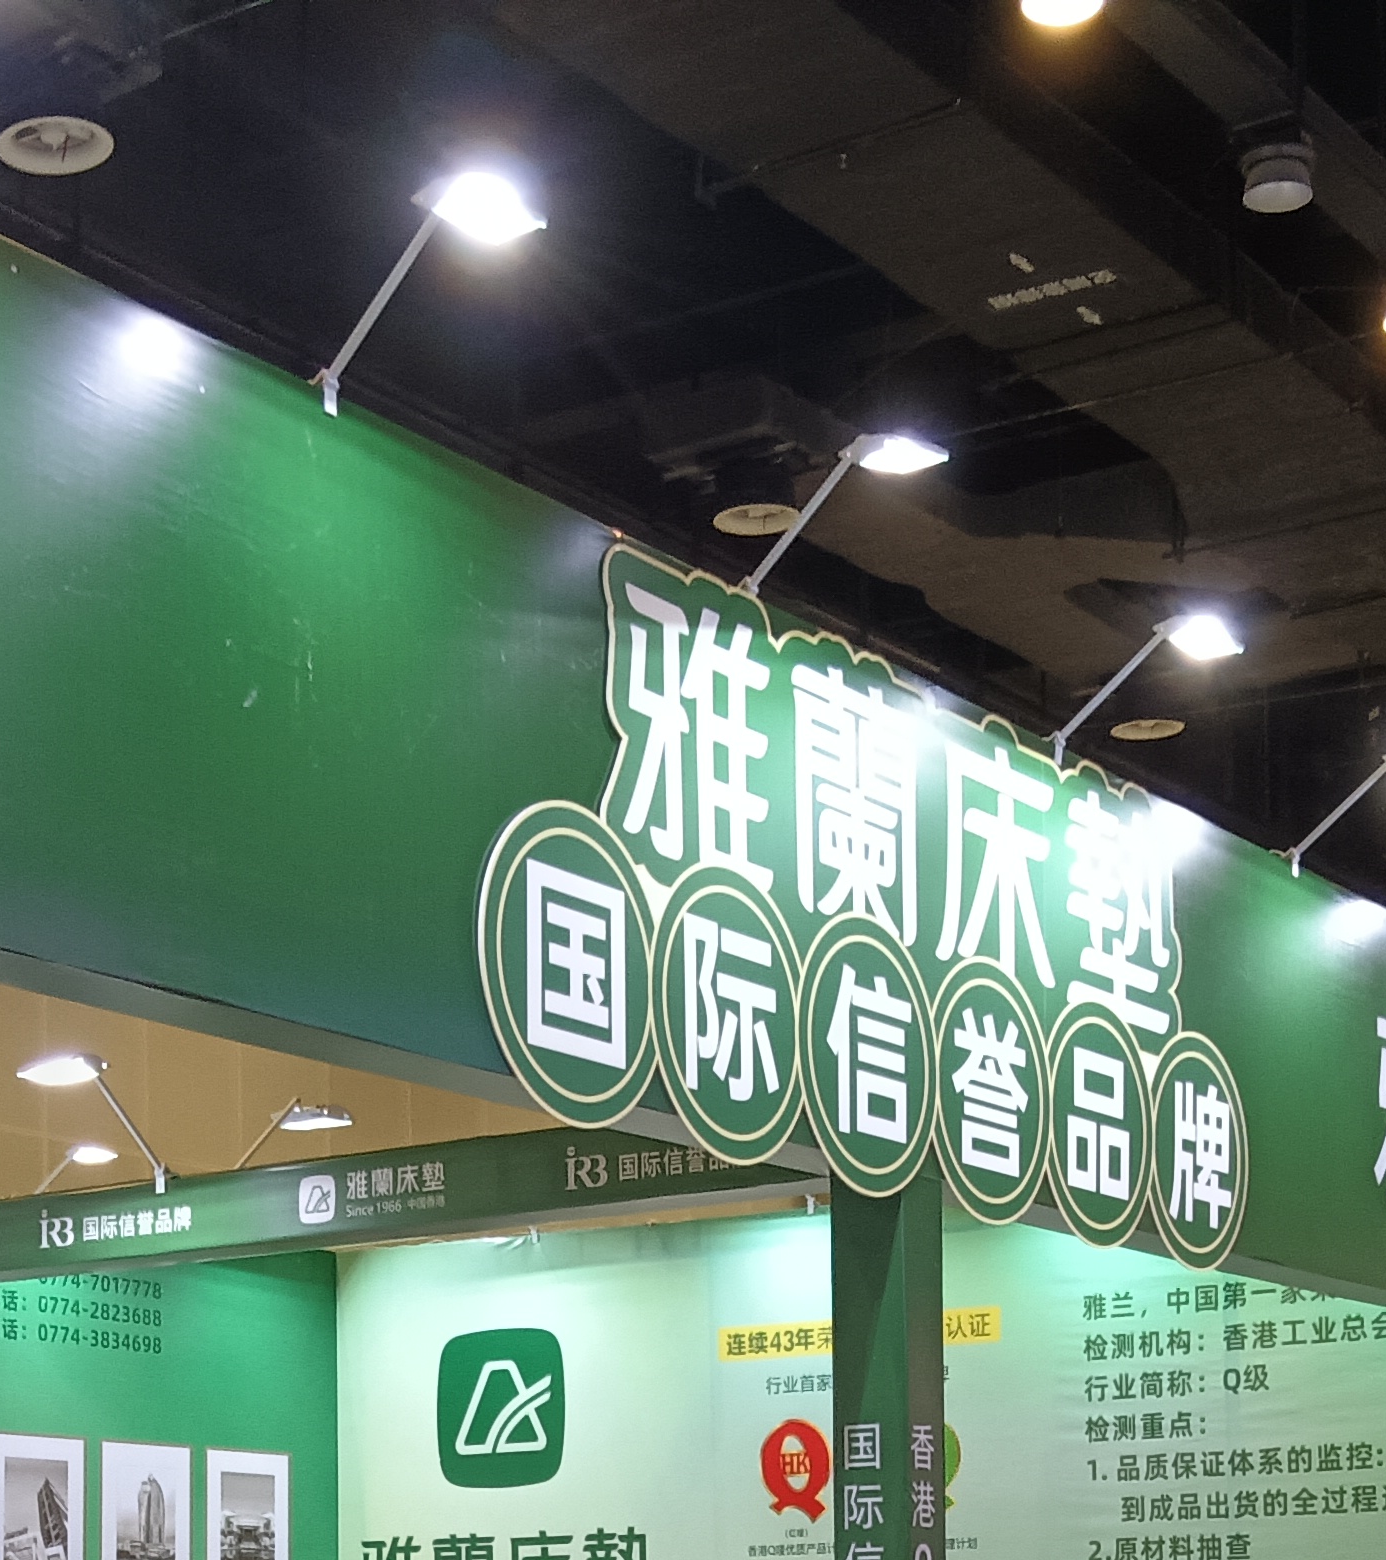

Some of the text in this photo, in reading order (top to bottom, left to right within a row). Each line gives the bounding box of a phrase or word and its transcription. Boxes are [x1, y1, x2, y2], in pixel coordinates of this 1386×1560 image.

[622, 581, 1173, 1035] 雅蘭床墊
[525, 857, 1233, 1229] 国际信誉品牌
[345, 1162, 445, 1200] 雅蘭床墊
[617, 1146, 731, 1182] 国际信誉品
[82, 1205, 193, 1242] 国际信誉品牌
[345, 1202, 374, 1218] Since
[376, 1200, 403, 1215] 1966
[1083, 1363, 1271, 1403] 行业简称：Q级
[1084, 1412, 1208, 1444] 检测重点：
